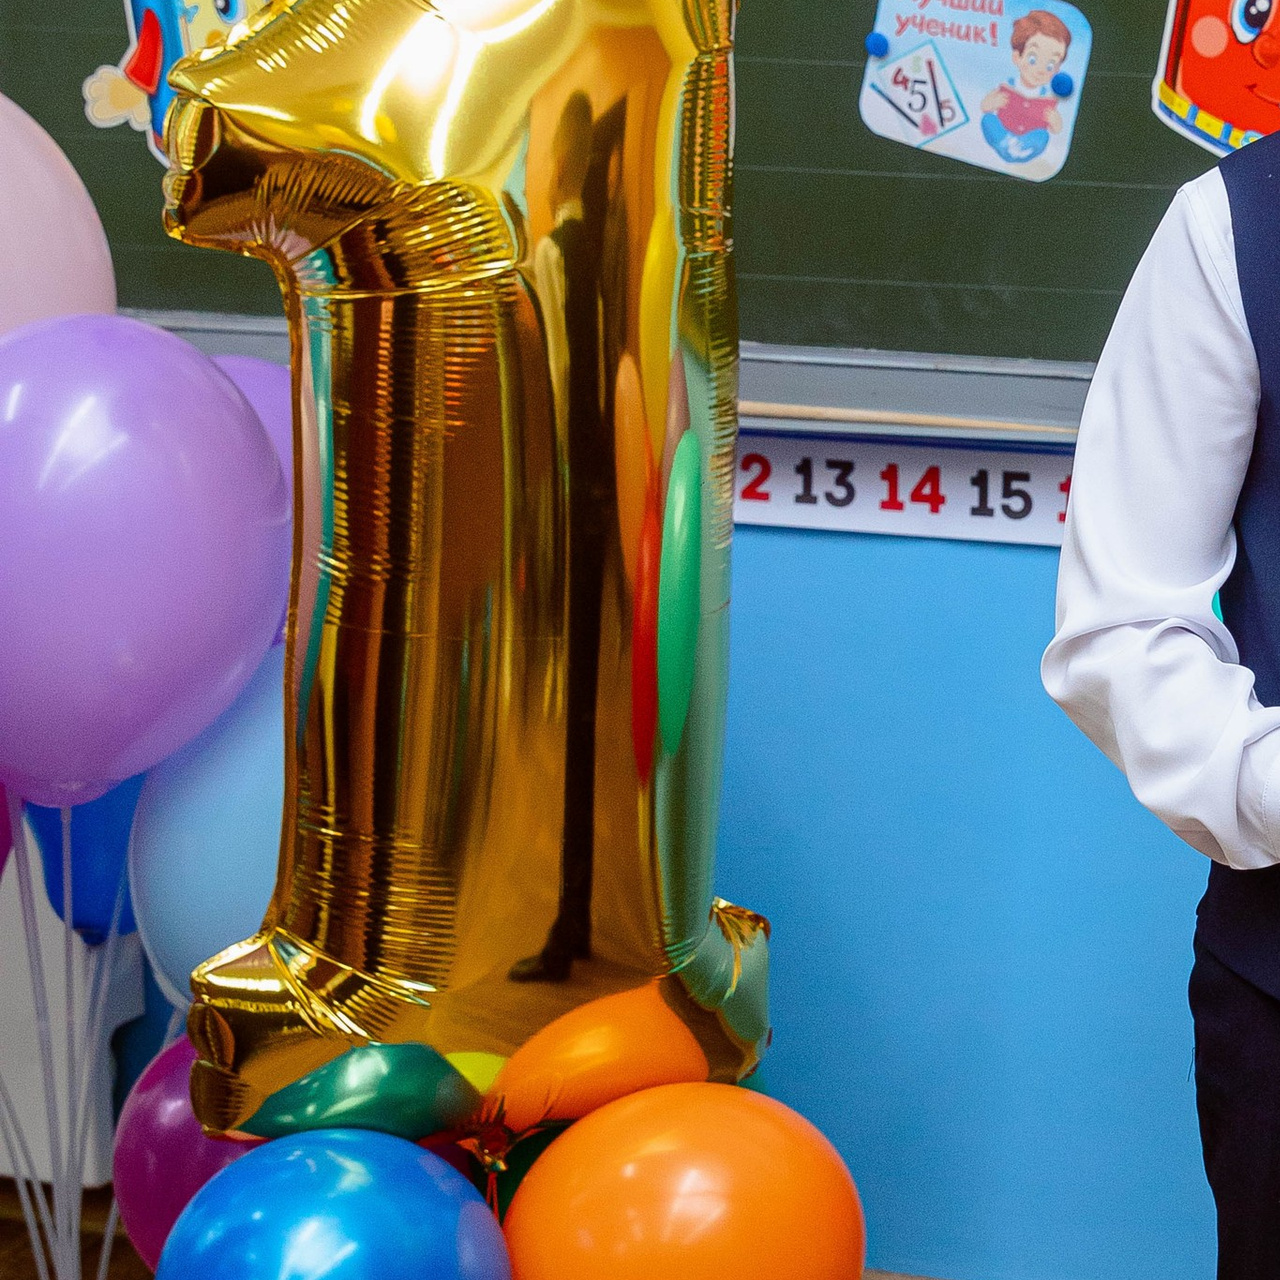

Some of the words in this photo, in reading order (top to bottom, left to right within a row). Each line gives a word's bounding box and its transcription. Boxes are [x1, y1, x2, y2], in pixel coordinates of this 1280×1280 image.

[895, 13, 998, 47] ученик!
[740, 452, 772, 502] 2
[795, 456, 855, 507] 13
[879, 462, 946, 514] 14
[970, 468, 1033, 520] 15
